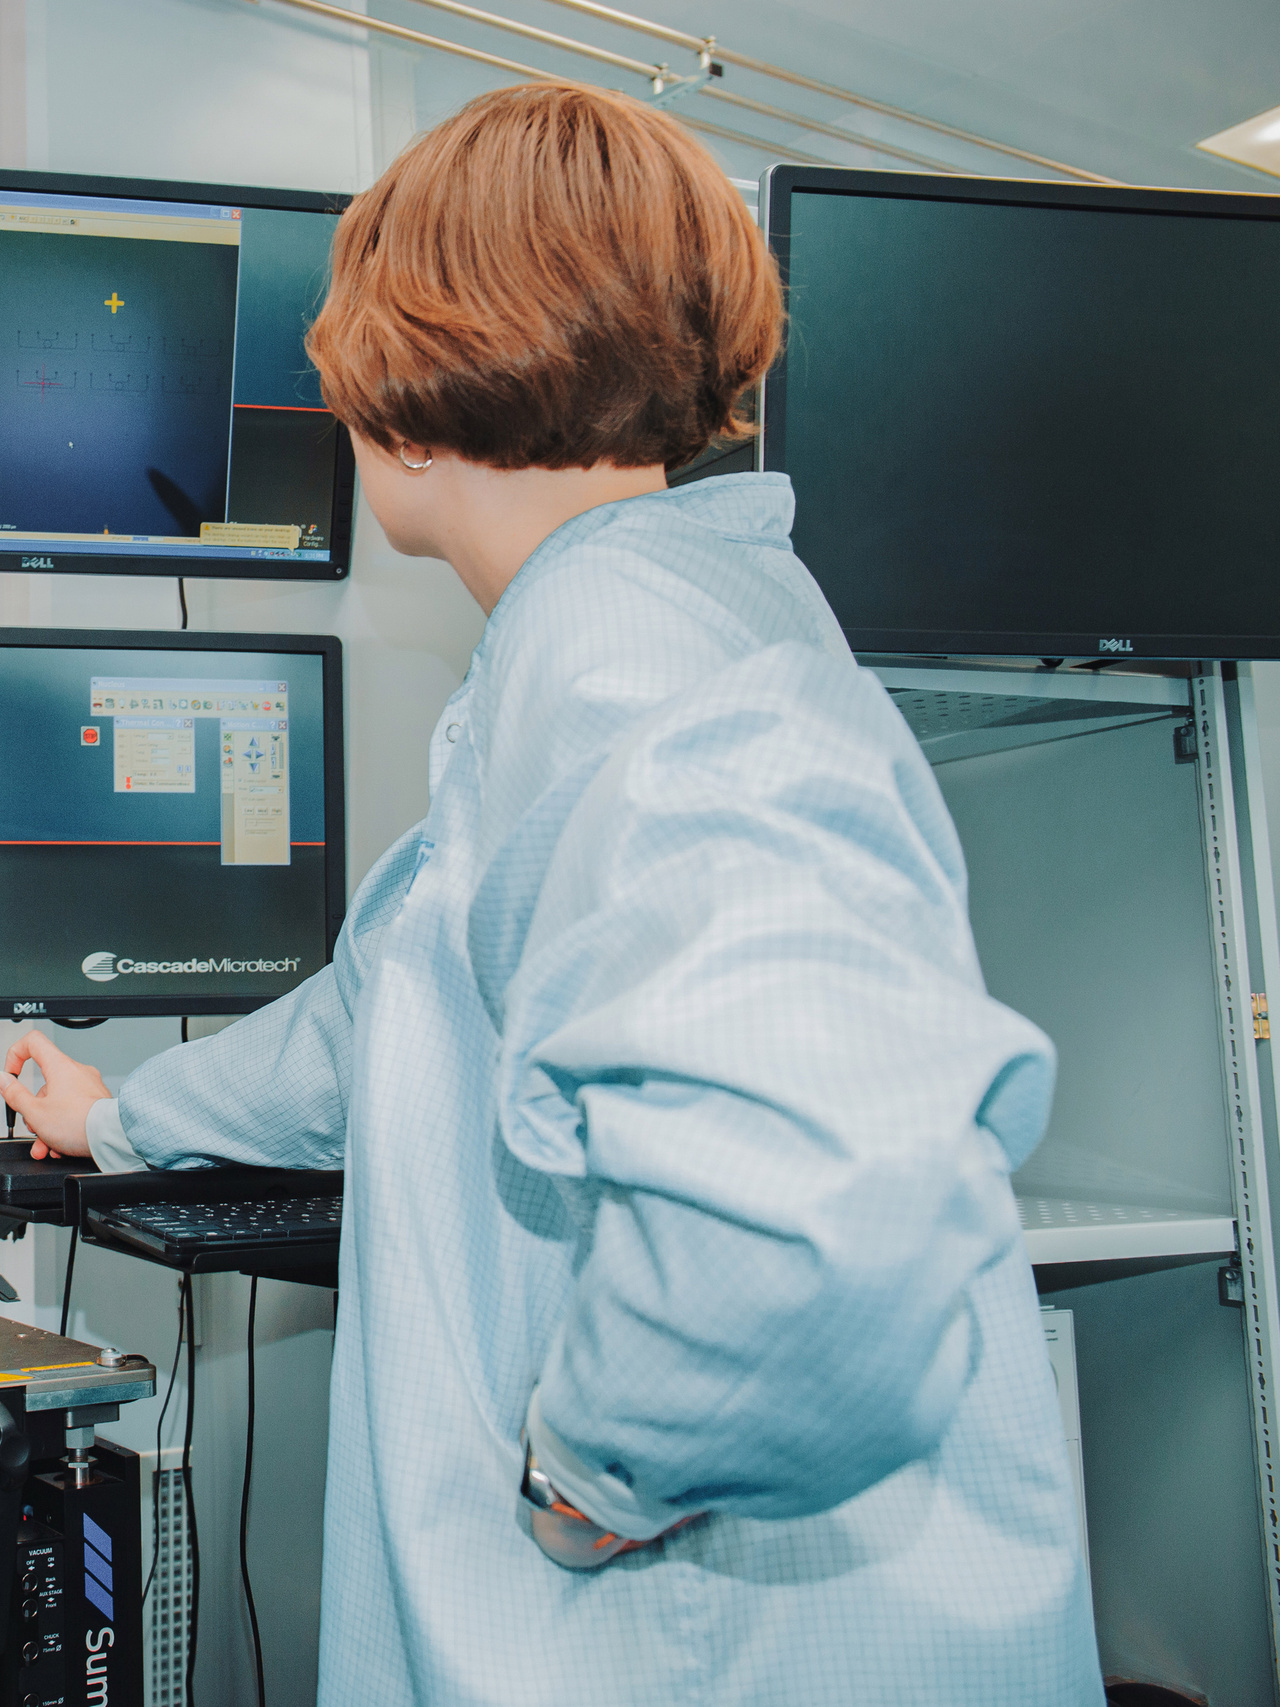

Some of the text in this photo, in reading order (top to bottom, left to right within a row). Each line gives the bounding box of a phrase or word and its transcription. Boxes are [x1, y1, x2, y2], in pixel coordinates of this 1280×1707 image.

[21, 556, 54, 569] DELL
[1099, 638, 1134, 652] DELL
[13, 1002, 47, 1014] DELL
[28, 1547, 53, 1556] VACUUM
[43, 1632, 60, 1640] CHUCK
